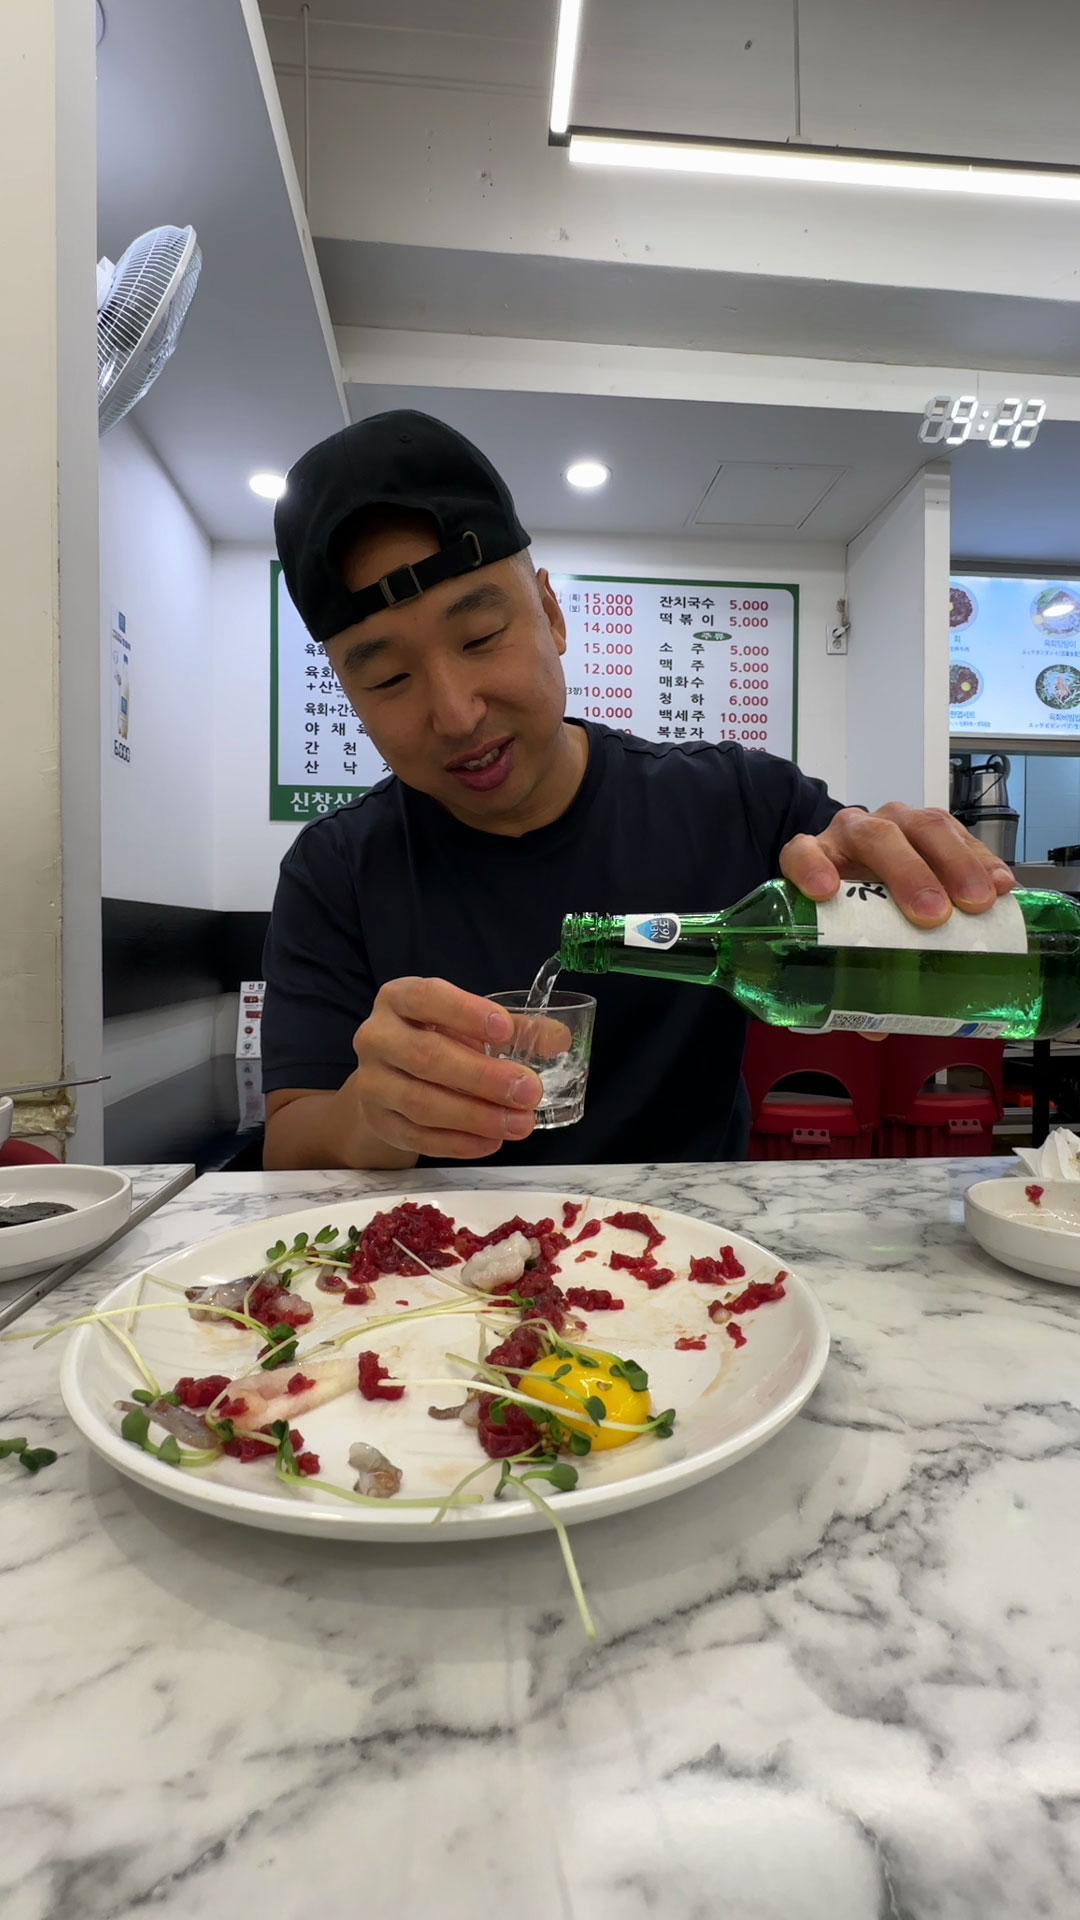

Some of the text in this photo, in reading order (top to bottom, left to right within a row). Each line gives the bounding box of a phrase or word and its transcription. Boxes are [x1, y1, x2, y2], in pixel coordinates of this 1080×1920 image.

[945, 395, 1047, 446] 9:22
[660, 596, 715, 609] 잔치국수
[304, 665, 335, 679] 육회
[659, 676, 705, 688] 매화수
[659, 709, 706, 722] 백세주
[657, 726, 704, 739] 복분자
[649, 919, 660, 939] NEW
